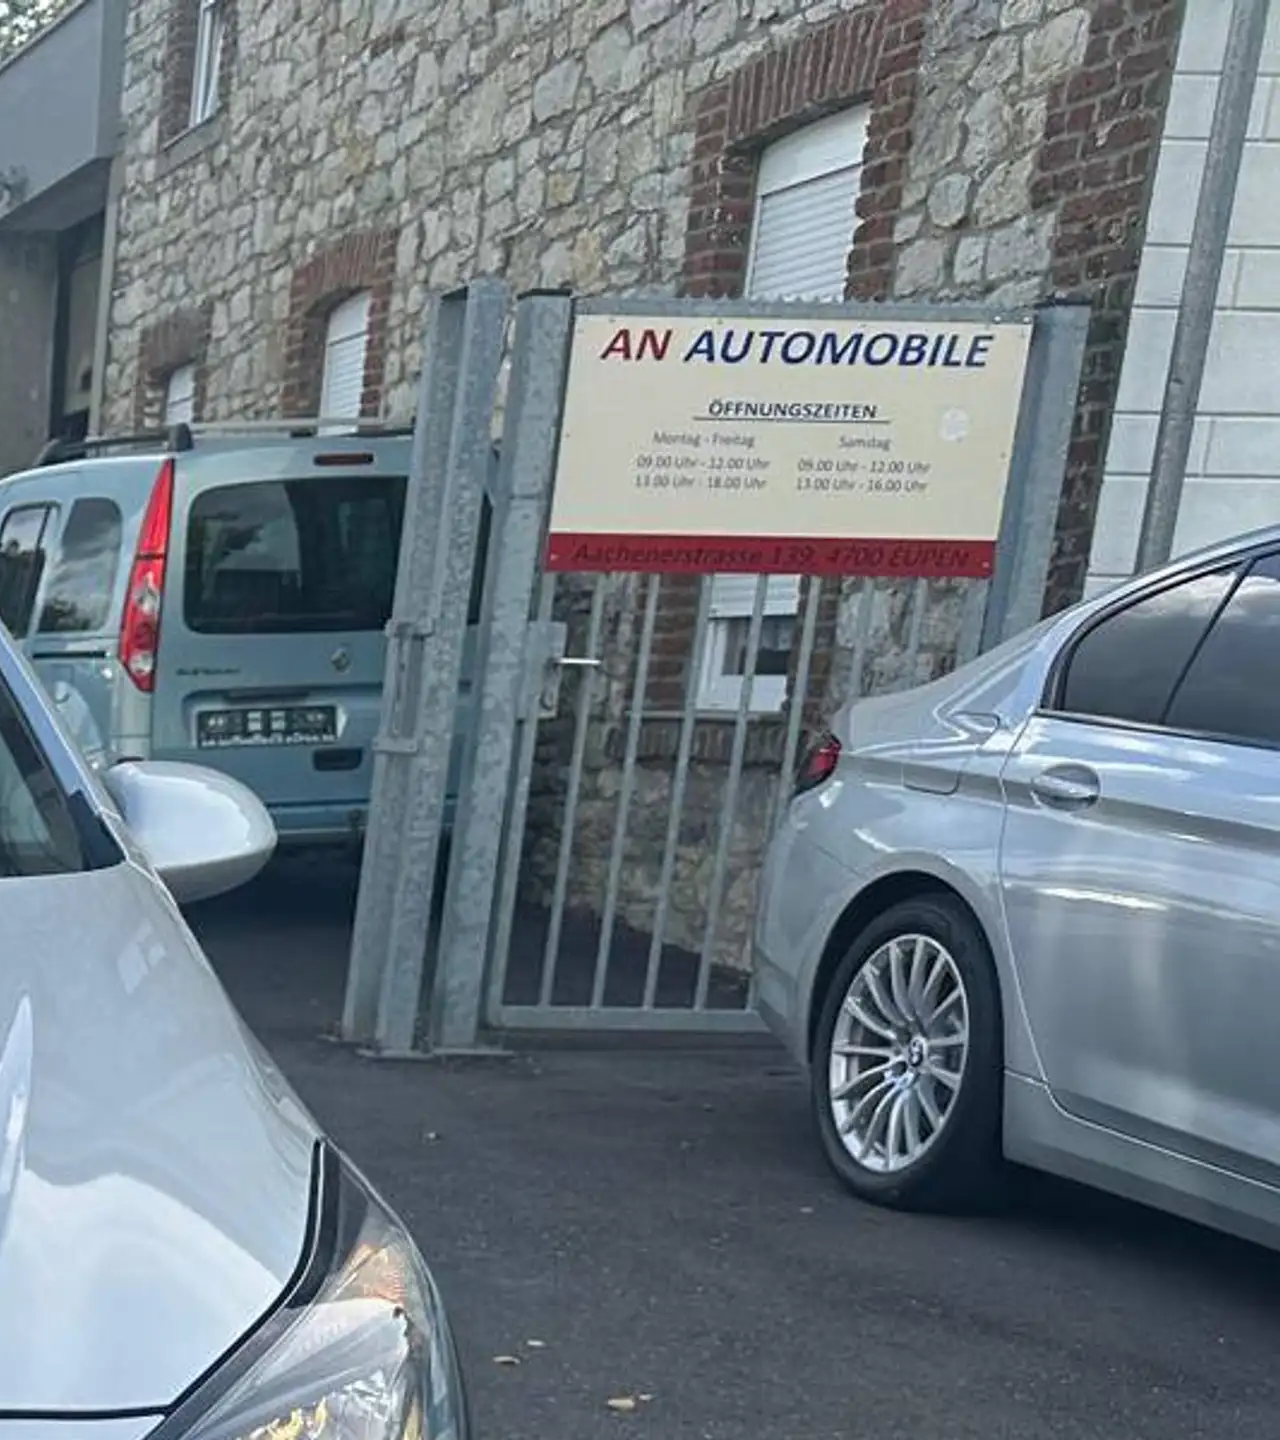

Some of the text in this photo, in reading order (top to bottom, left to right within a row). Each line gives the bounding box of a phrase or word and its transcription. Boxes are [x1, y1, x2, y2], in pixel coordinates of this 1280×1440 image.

[600, 328, 994, 367] AN AUTOMOBILE
[708, 399, 878, 419] ÖFFNUNGSZEITEN
